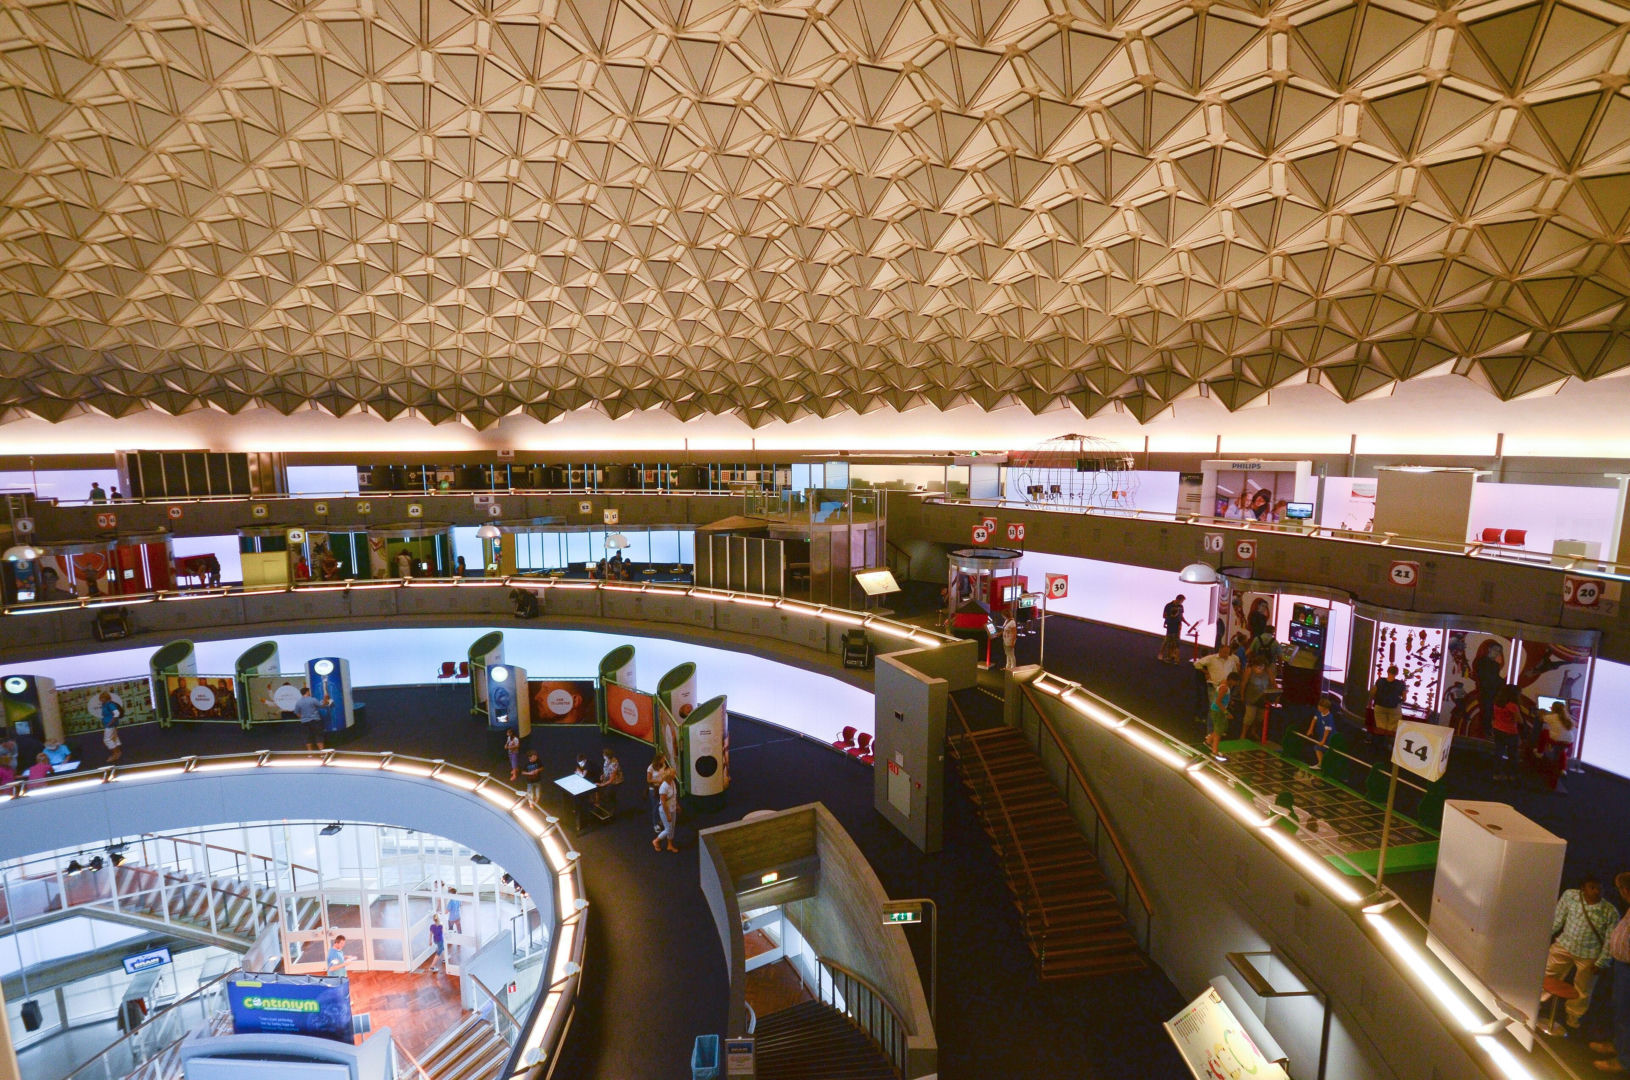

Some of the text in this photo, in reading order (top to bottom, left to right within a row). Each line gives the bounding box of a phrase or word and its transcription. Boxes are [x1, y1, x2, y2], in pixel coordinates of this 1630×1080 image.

[1239, 546, 1251, 554] 22
[1394, 569, 1410, 579] 21
[1054, 583, 1065, 592] 30
[1580, 589, 1596, 597] 20
[1403, 739, 1428, 762] 14
